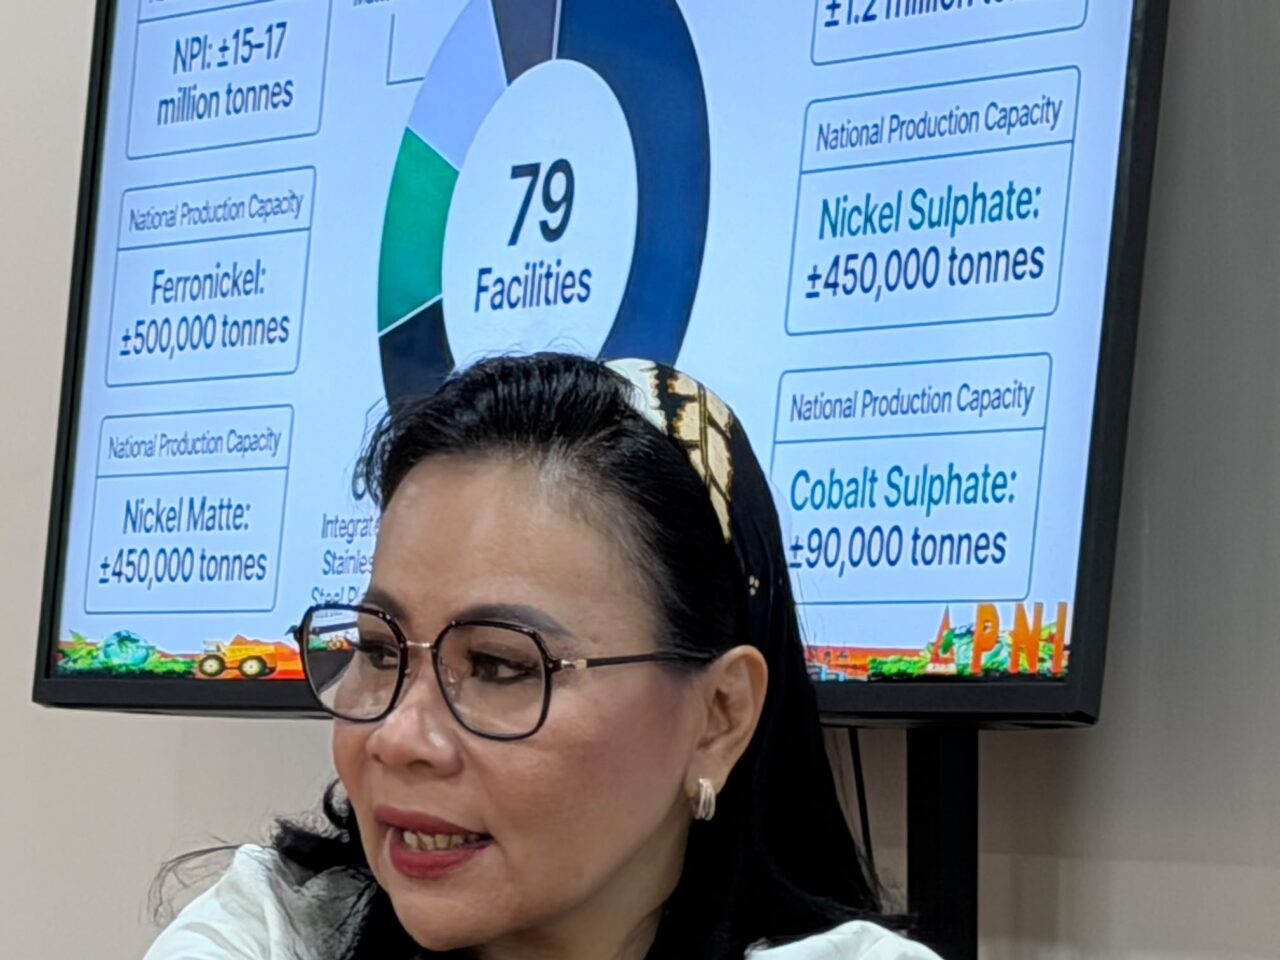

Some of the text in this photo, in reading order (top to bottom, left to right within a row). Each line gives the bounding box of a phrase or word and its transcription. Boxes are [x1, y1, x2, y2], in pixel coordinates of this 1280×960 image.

[173, 35, 213, 74] NPI:
[157, 79, 294, 126] million tonnes
[816, 94, 1063, 152] National Production Capacity
[129, 189, 304, 231] National Production Capacity
[507, 158, 575, 247] 79
[818, 180, 1041, 240] Nickel Sulphate:
[151, 258, 266, 305] Ferronickel:
[474, 259, 592, 313] Facilities
[805, 245, 1045, 302] ±450,000 tonnes
[119, 314, 290, 360] ±500,000 tonnes
[790, 379, 1035, 422] National Production Capacity
[108, 427, 282, 460] National Production Capacity
[790, 462, 1017, 518] Cobalt Sulphate:
[122, 496, 251, 535] Nickel Matte:
[98, 547, 267, 590] ±450,000 tonnes
[788, 525, 1007, 578] ±90,000 tonnes
[926, 602, 1068, 675] APNI
